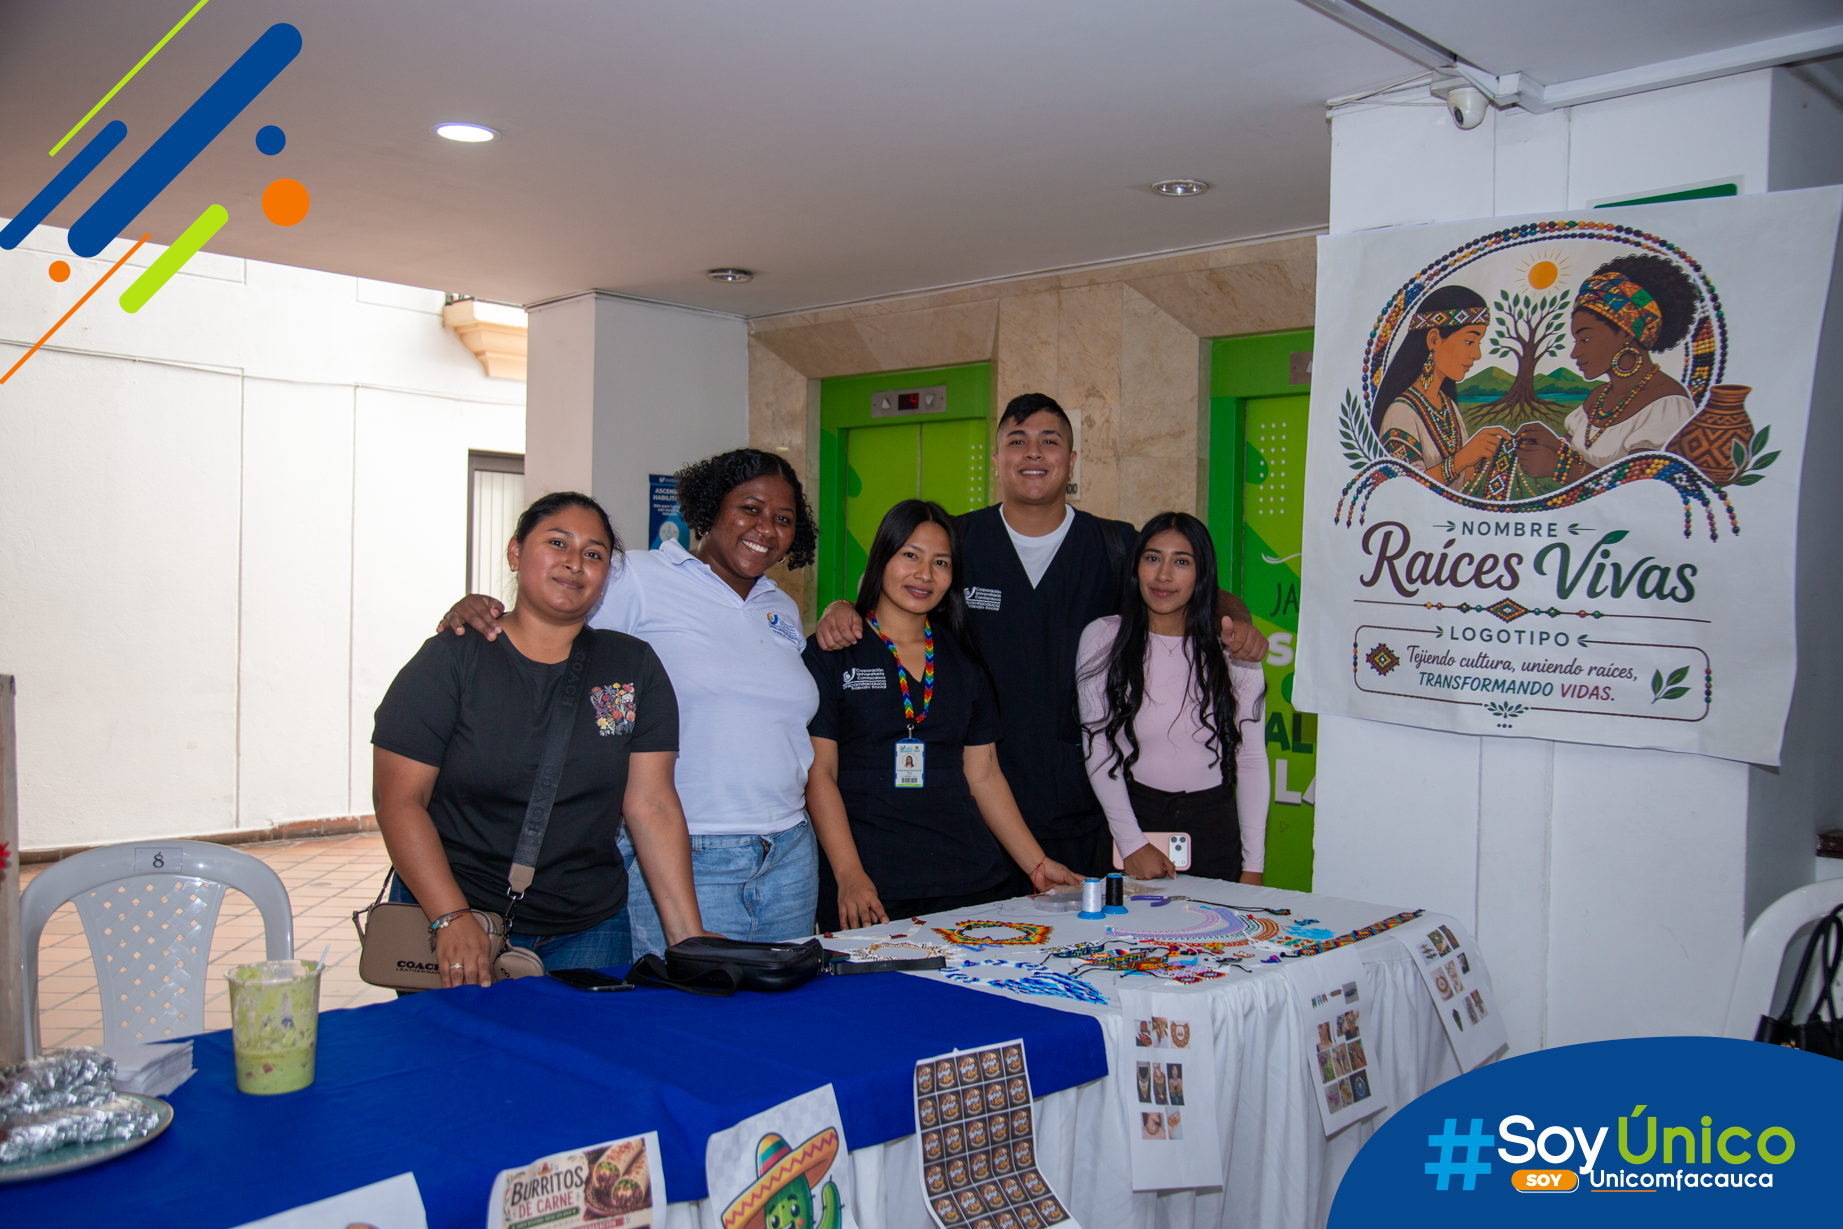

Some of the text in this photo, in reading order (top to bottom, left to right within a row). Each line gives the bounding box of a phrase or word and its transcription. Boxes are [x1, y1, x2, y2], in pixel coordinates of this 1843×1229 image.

[910, 393, 919, 408] 4
[1461, 520, 1558, 538] NOMBRE
[1360, 521, 1698, 603] Raíces Vivas
[1450, 626, 1570, 647] LOGOTIPO
[1407, 645, 1638, 682] Tejiendo cultura, uniendo raíces,
[1419, 671, 1615, 701] TRANSFORMANDO VIDAS.
[153, 851, 165, 868] 8
[396, 967, 440, 975] LEATHERWAR
[511, 1166, 584, 1207] BURRITOS
[519, 1201, 533, 1219] DE
[537, 1191, 574, 1213] CARNE
